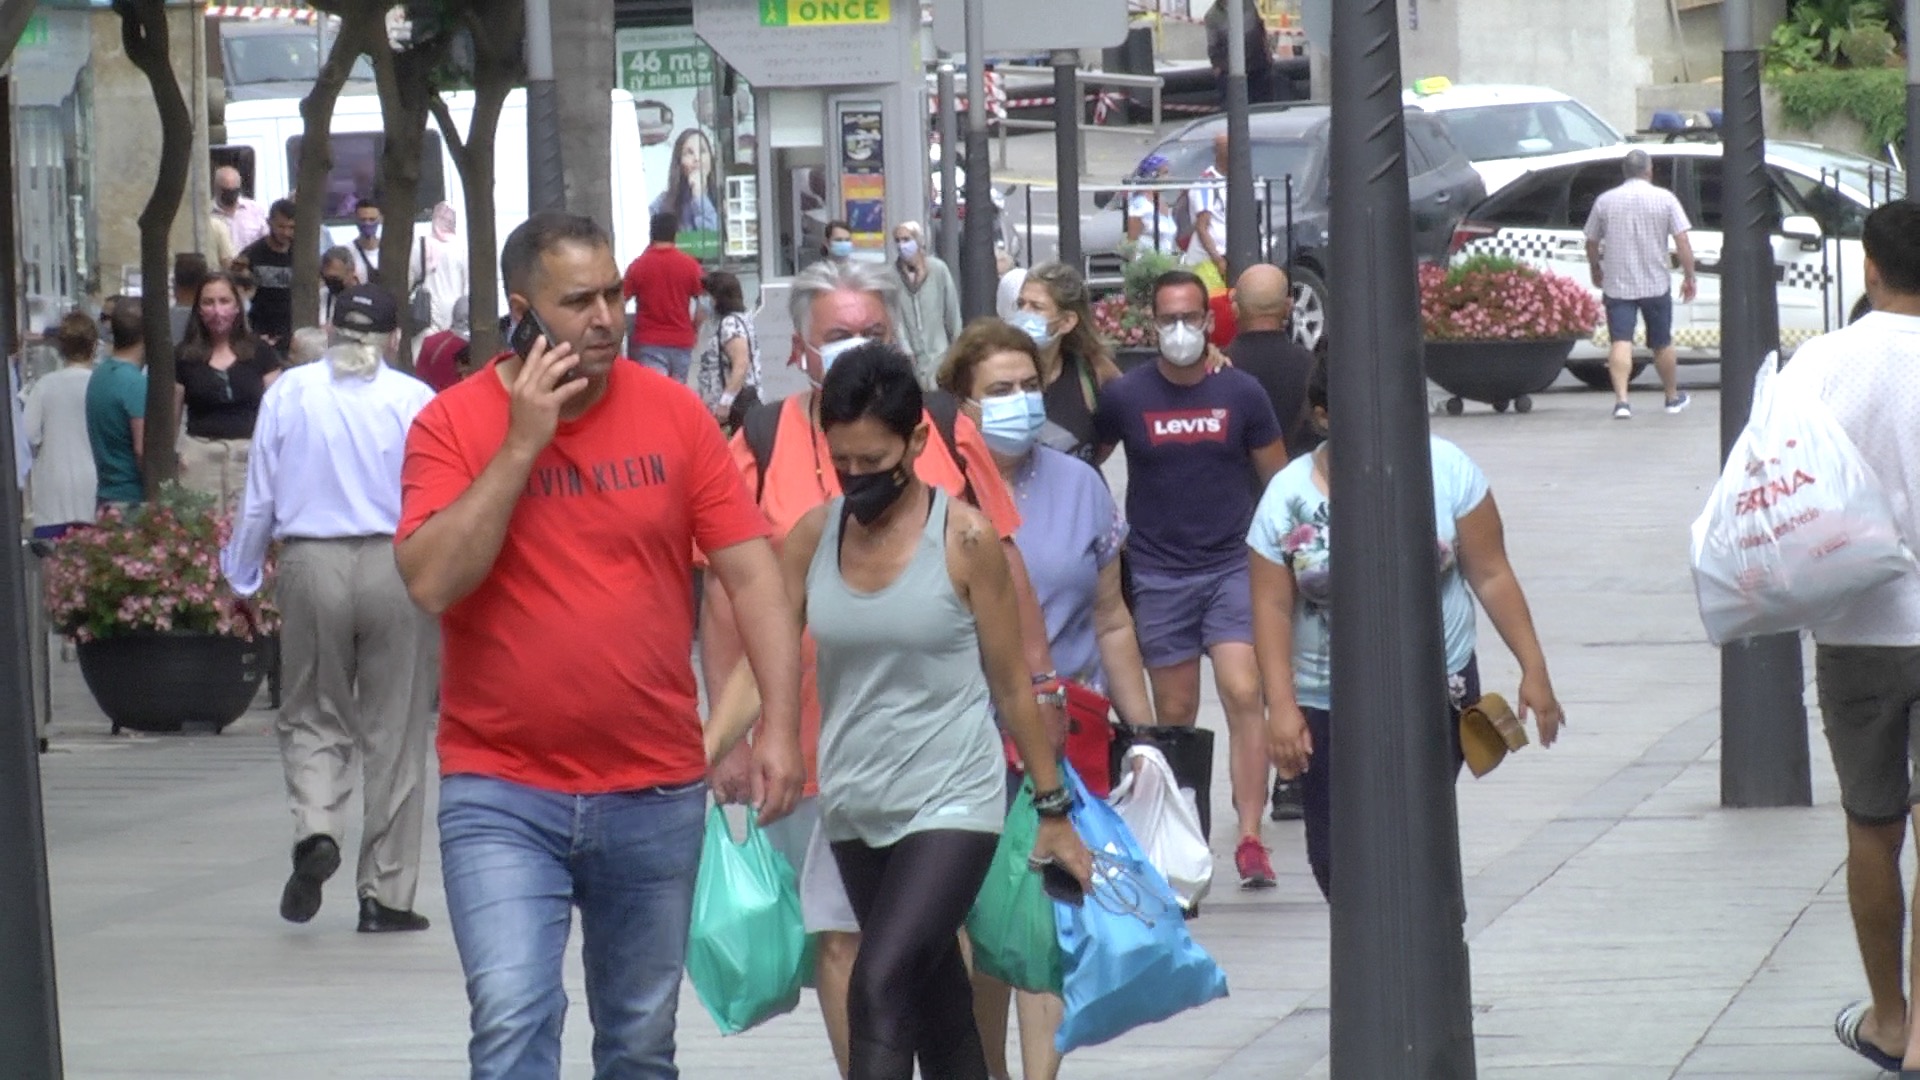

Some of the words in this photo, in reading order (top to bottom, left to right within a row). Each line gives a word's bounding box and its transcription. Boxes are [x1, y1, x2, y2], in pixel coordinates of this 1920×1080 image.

[799, 1, 880, 21] ONCE
[630, 50, 662, 73] 46
[648, 72, 672, 87] sin
[592, 453, 666, 493] KLEIN
